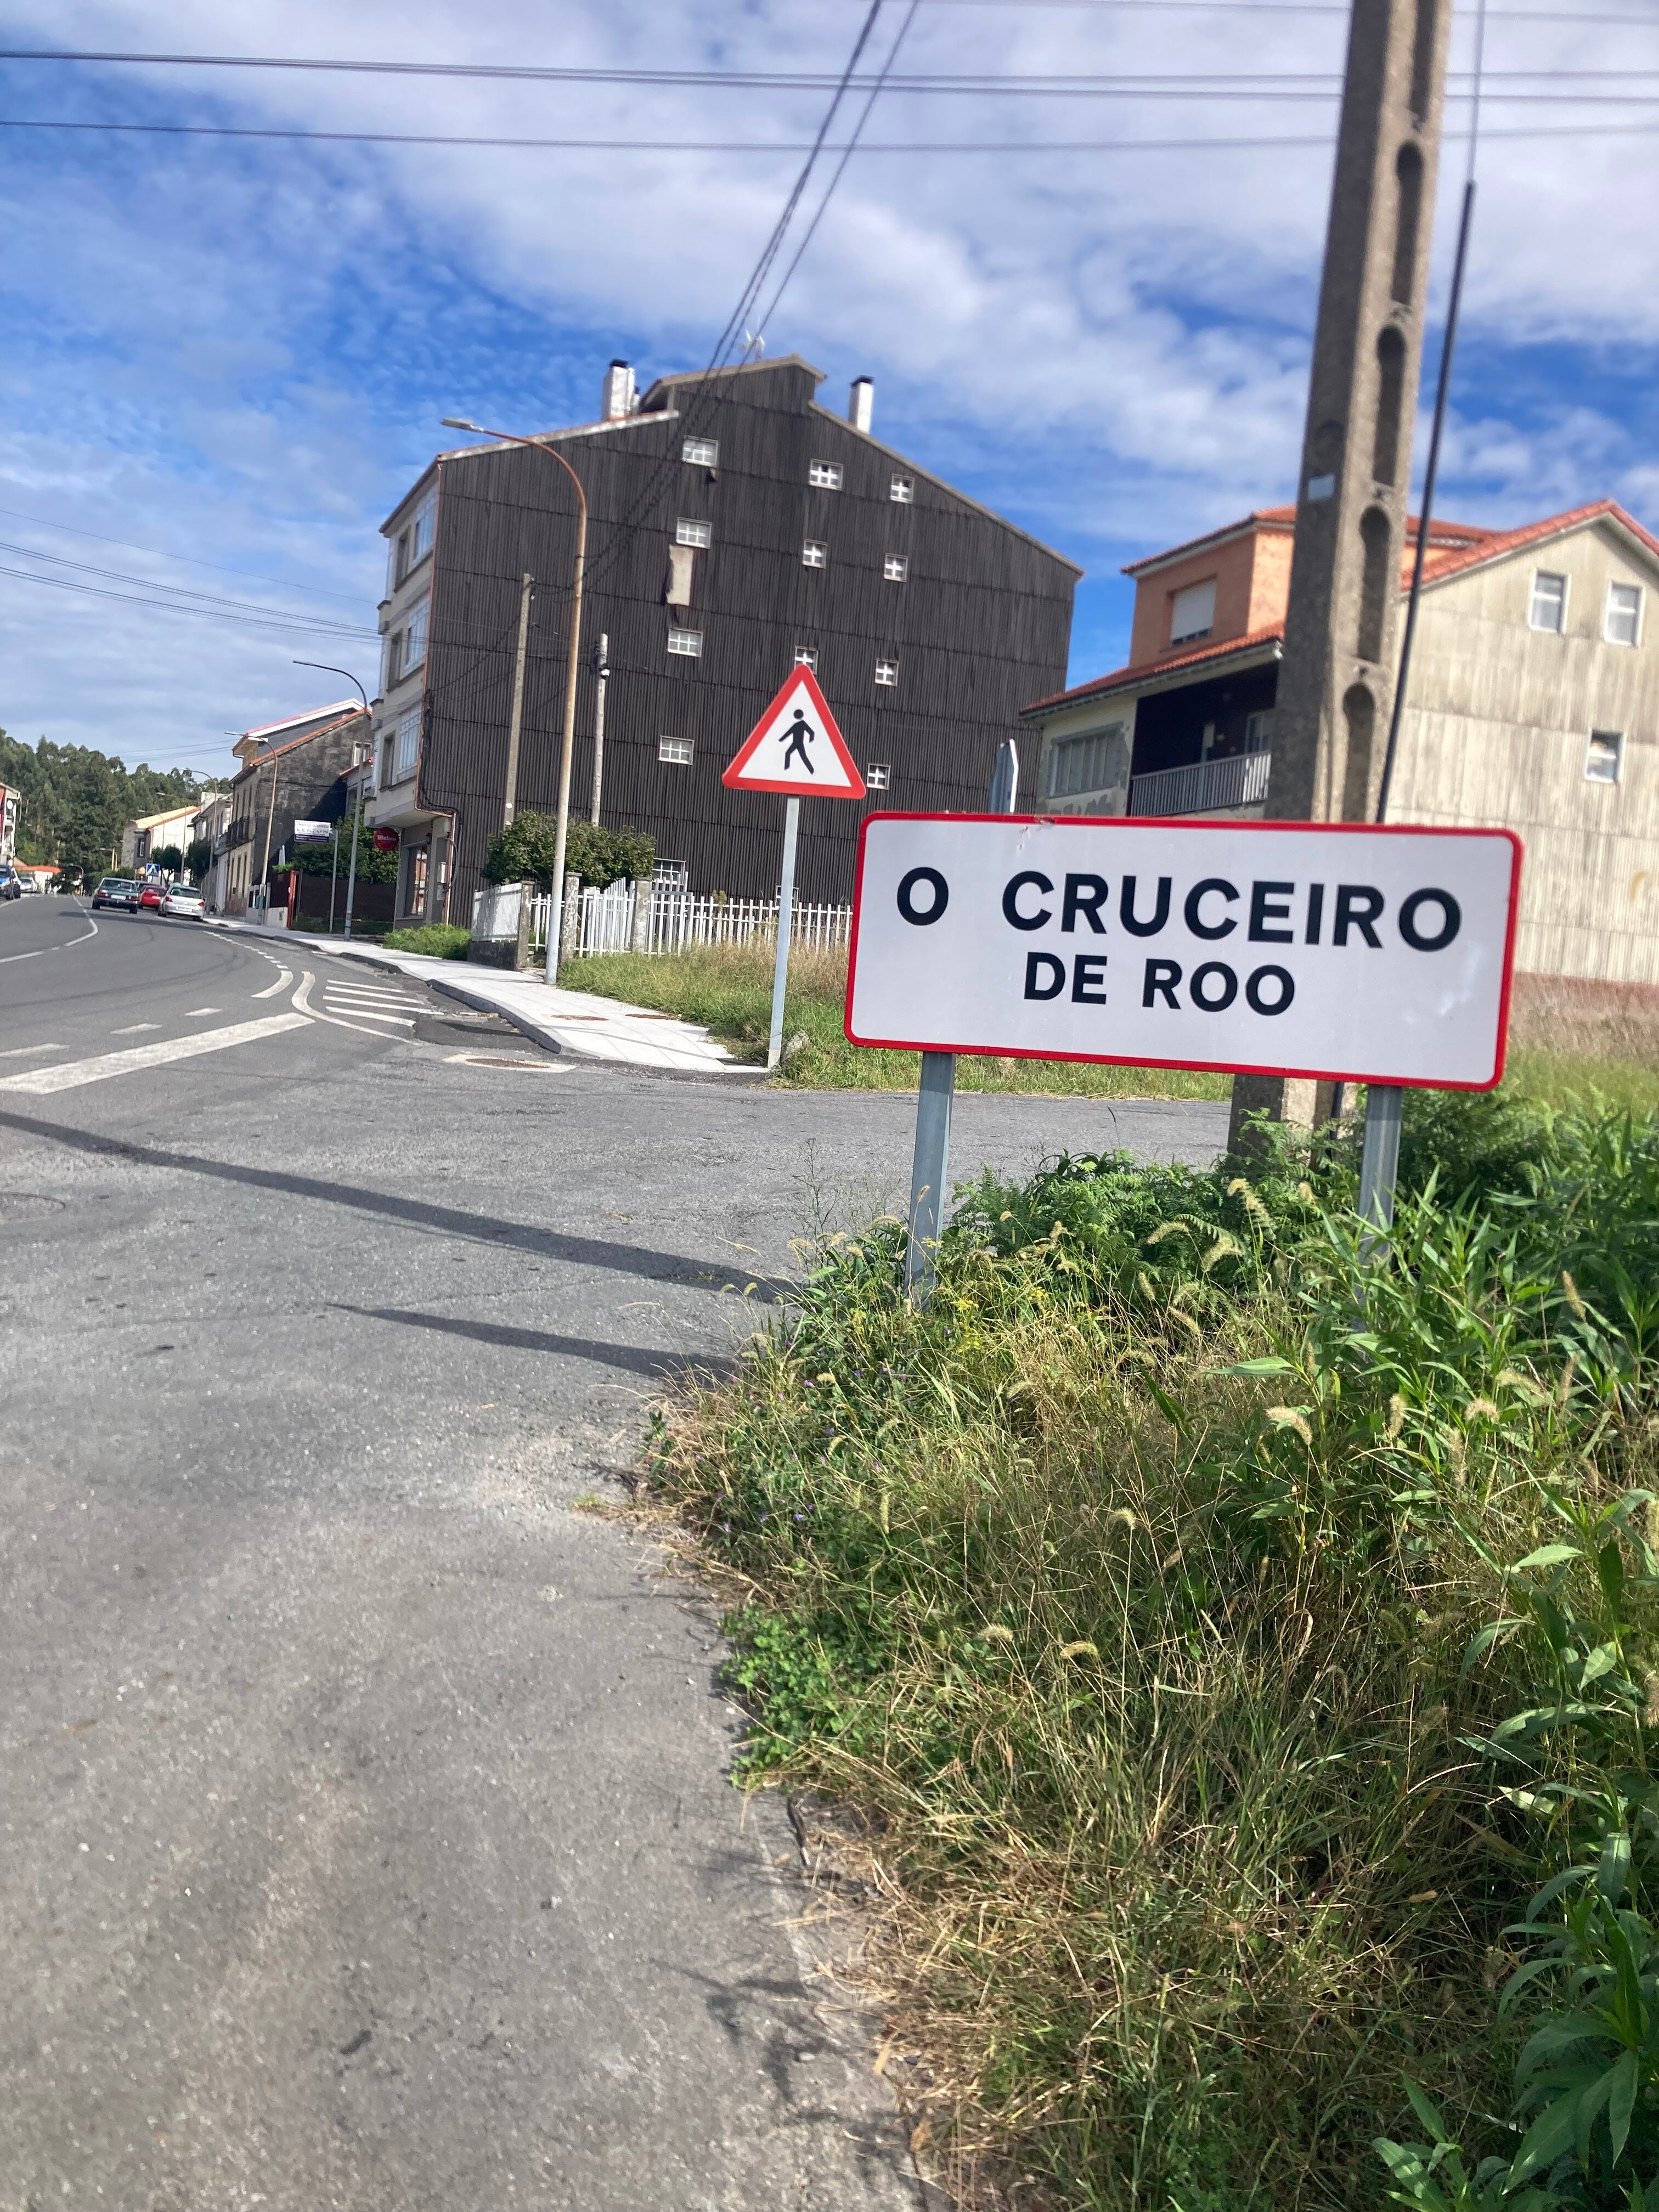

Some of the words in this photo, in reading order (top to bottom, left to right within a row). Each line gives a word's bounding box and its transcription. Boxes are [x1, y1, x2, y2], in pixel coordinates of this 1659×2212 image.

[896, 866, 950, 927] O
[1001, 870, 1462, 953] CRUCEIRO
[1023, 951, 1108, 1006] DE
[1142, 958, 1295, 1017] ROO
